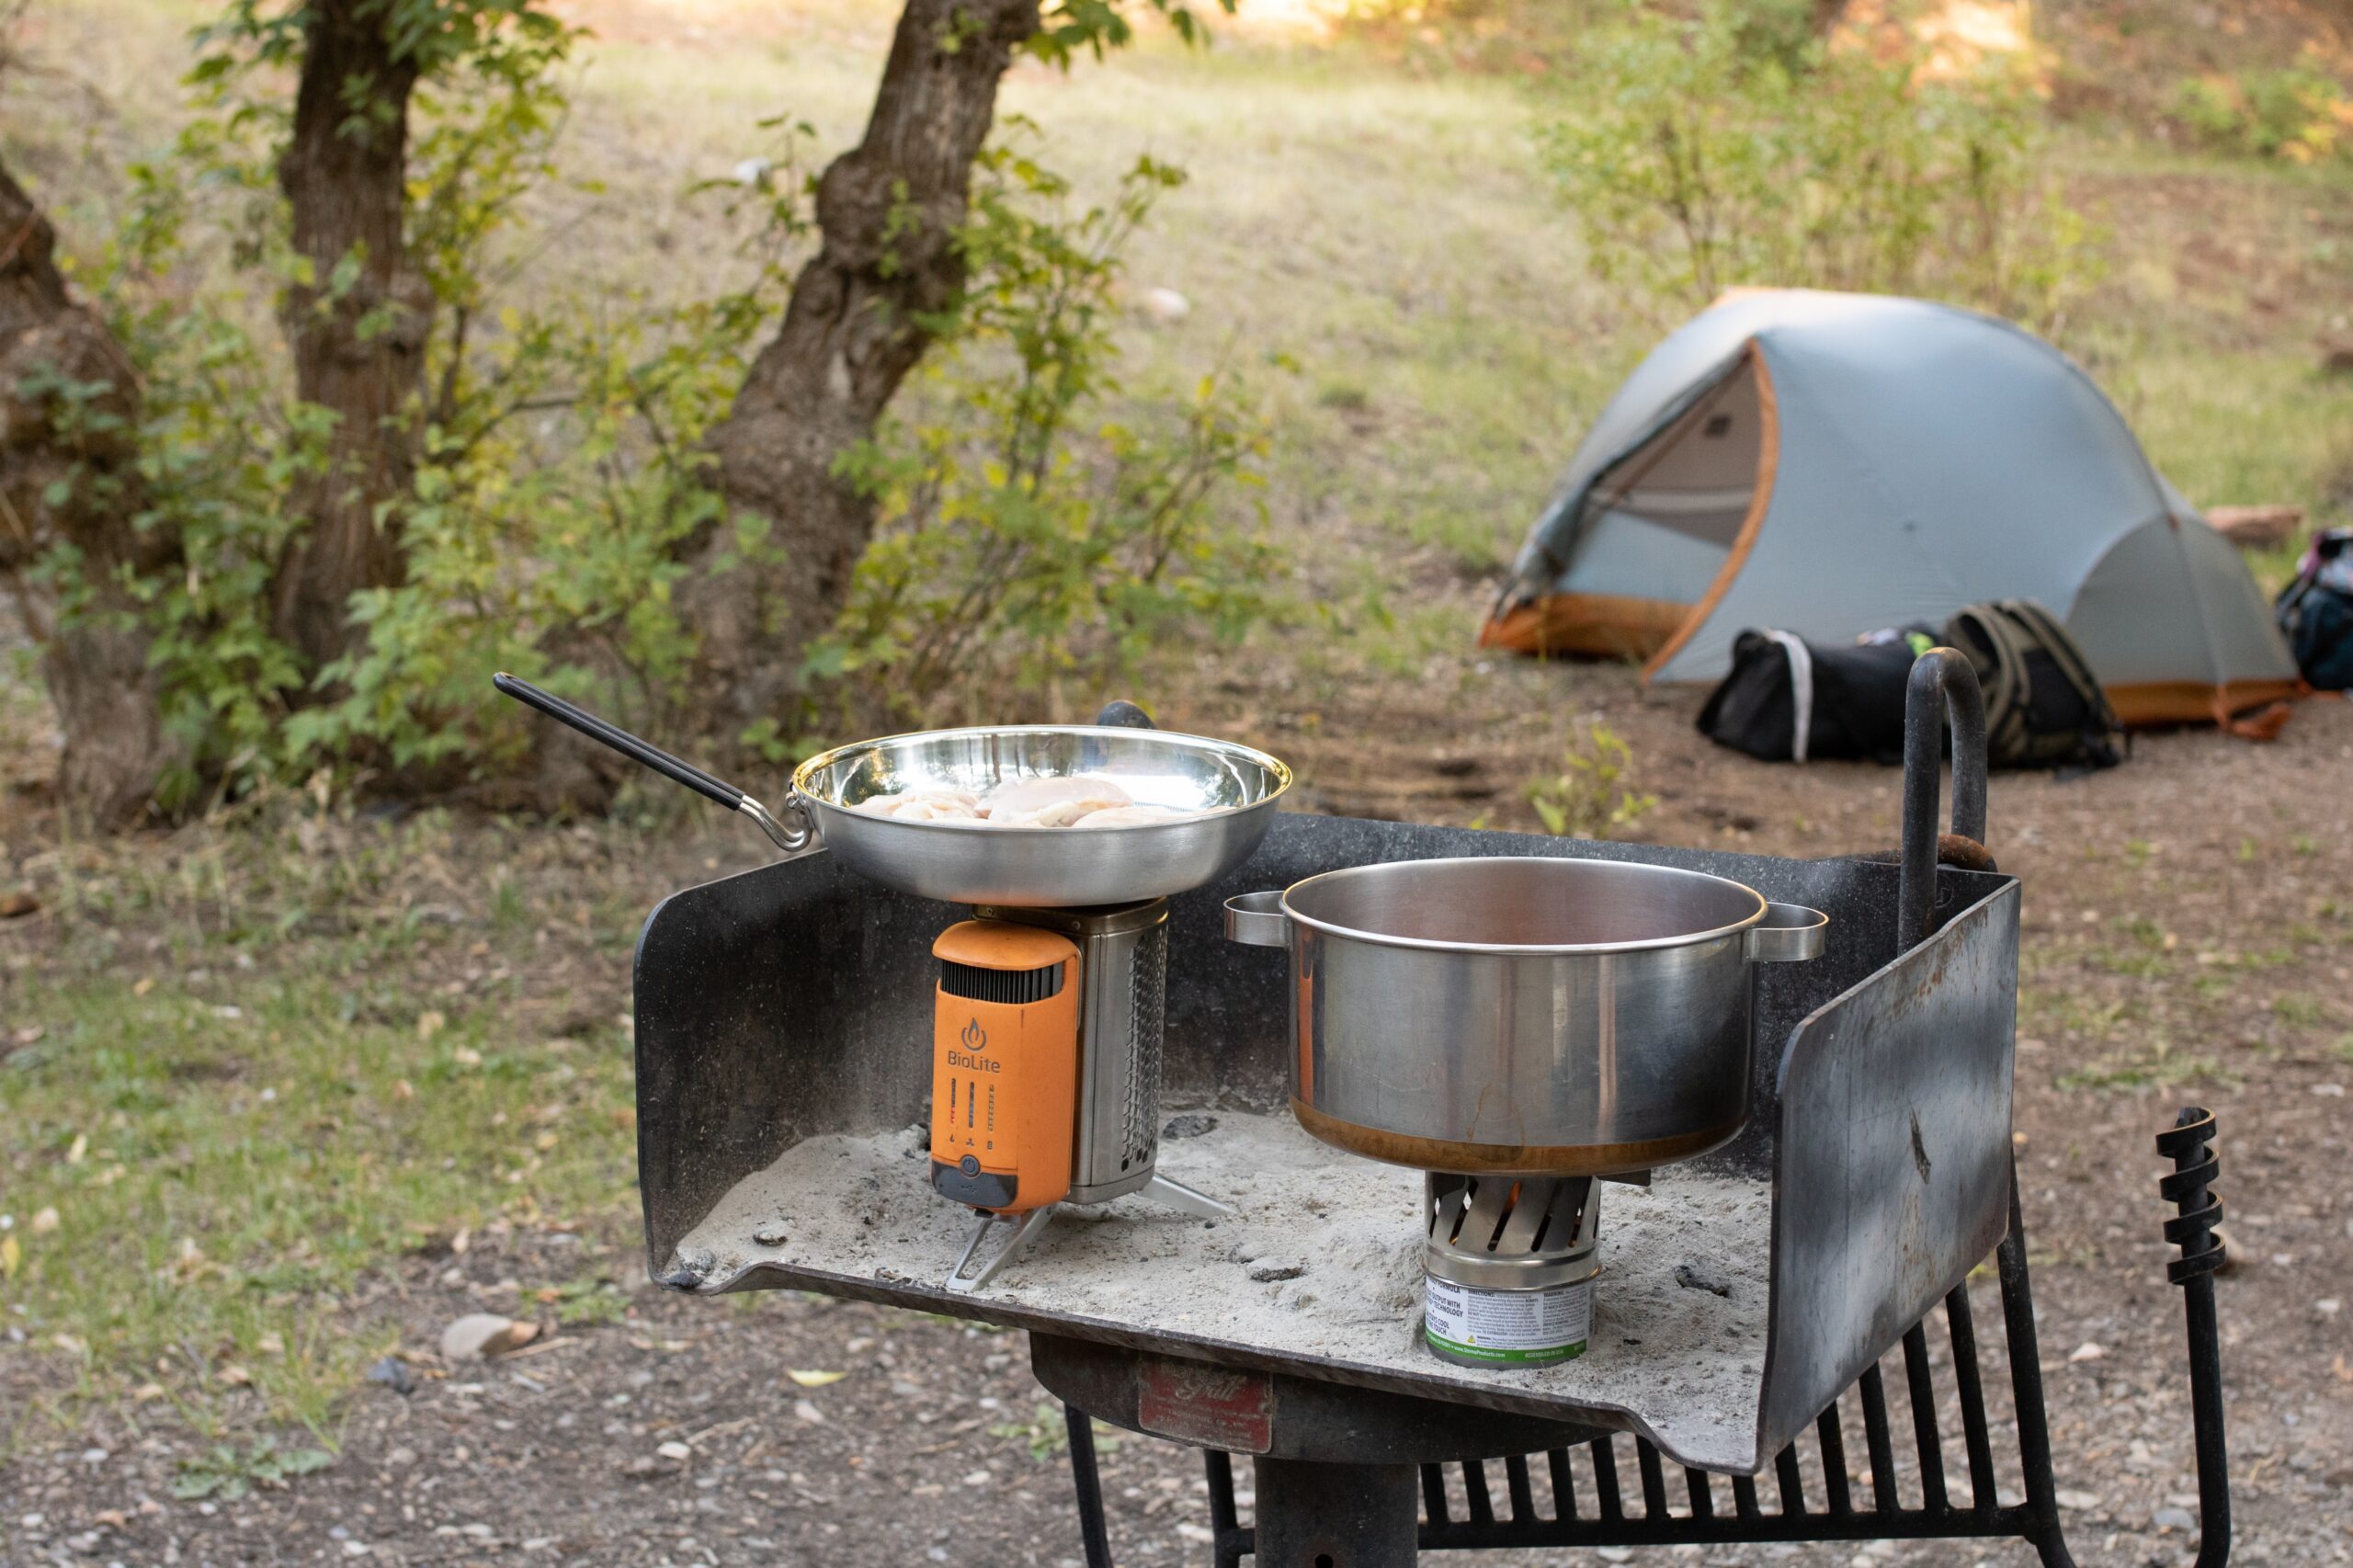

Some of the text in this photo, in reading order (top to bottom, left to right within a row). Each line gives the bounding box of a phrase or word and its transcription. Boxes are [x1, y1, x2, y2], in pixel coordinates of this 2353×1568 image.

[948, 1051, 1001, 1074] BioLite
[1432, 1292, 1446, 1304] OUTPUT
[1447, 1300, 1461, 1309] WITH
[1434, 1301, 1463, 1317] TECHNOLOGY
[1434, 1324, 1447, 1335] TOUCH
[1438, 1318, 1449, 1329] COOL
